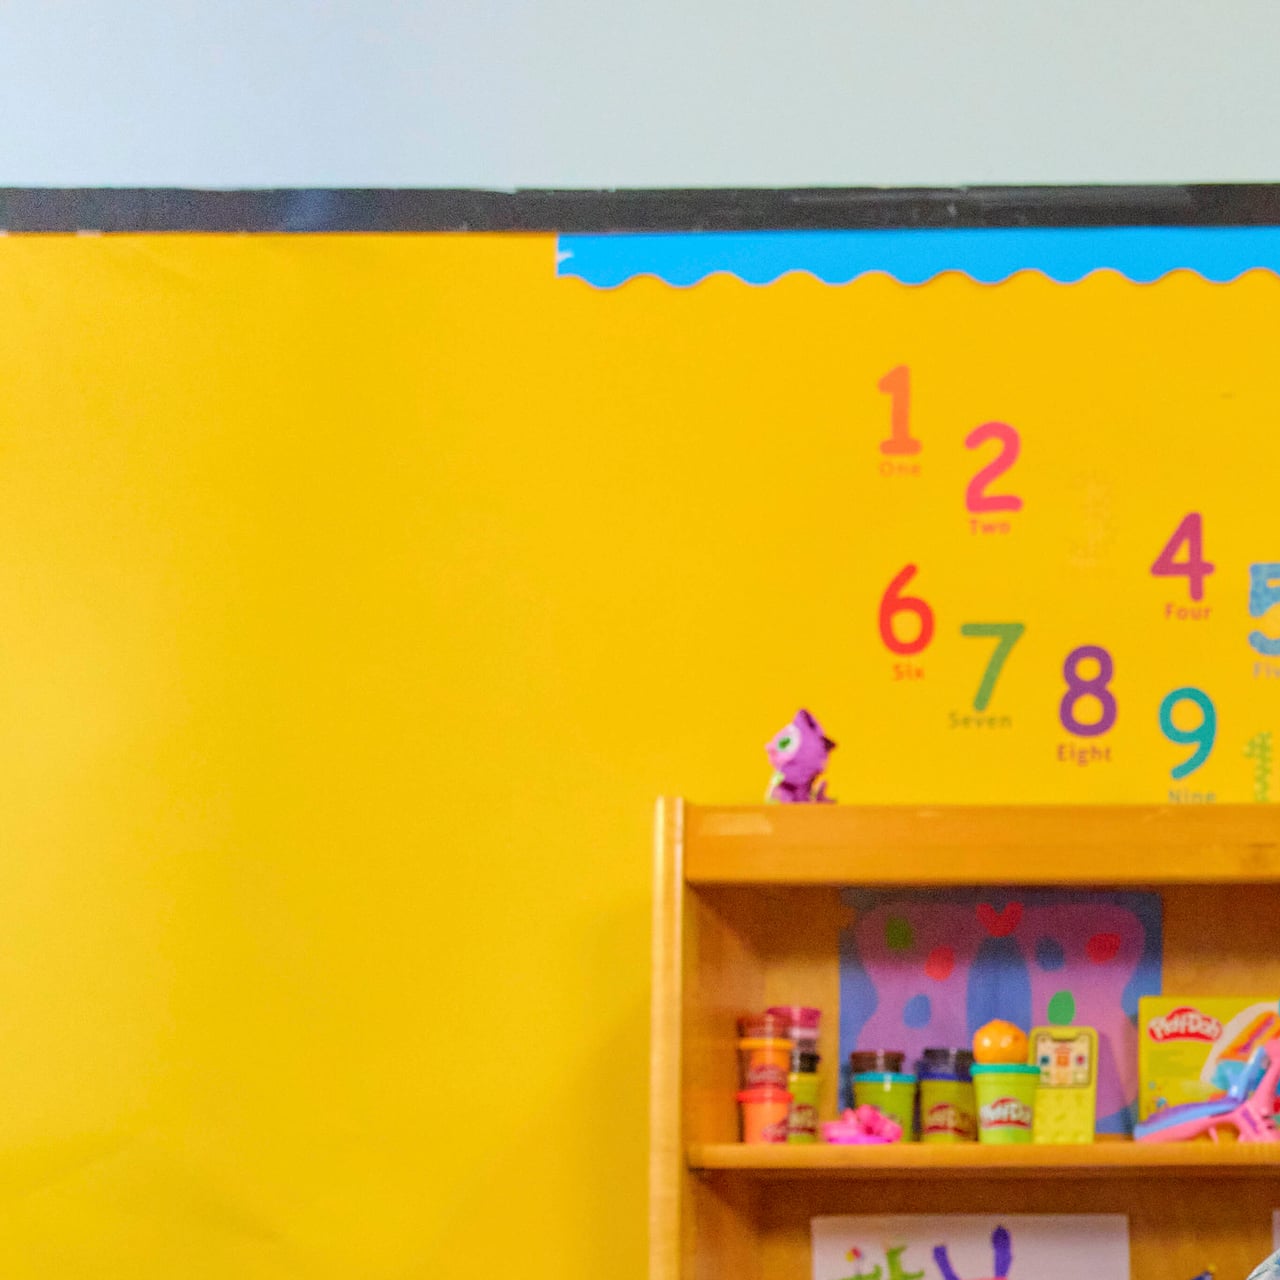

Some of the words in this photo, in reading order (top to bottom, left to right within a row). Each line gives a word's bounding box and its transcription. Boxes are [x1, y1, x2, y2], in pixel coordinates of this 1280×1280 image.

[878, 364, 922, 455] 1
[879, 460, 922, 478] One
[964, 421, 1023, 513] 2
[969, 518, 1011, 536] Two
[1150, 512, 1215, 601] 4
[878, 563, 934, 655] 6
[1164, 602, 1212, 621] Four
[892, 664, 925, 681] Six
[960, 622, 1026, 711] 7
[1059, 645, 1117, 737] 8
[948, 711, 1012, 730] Seven
[1057, 743, 1112, 767] Eight
[1158, 686, 1217, 780] 9
